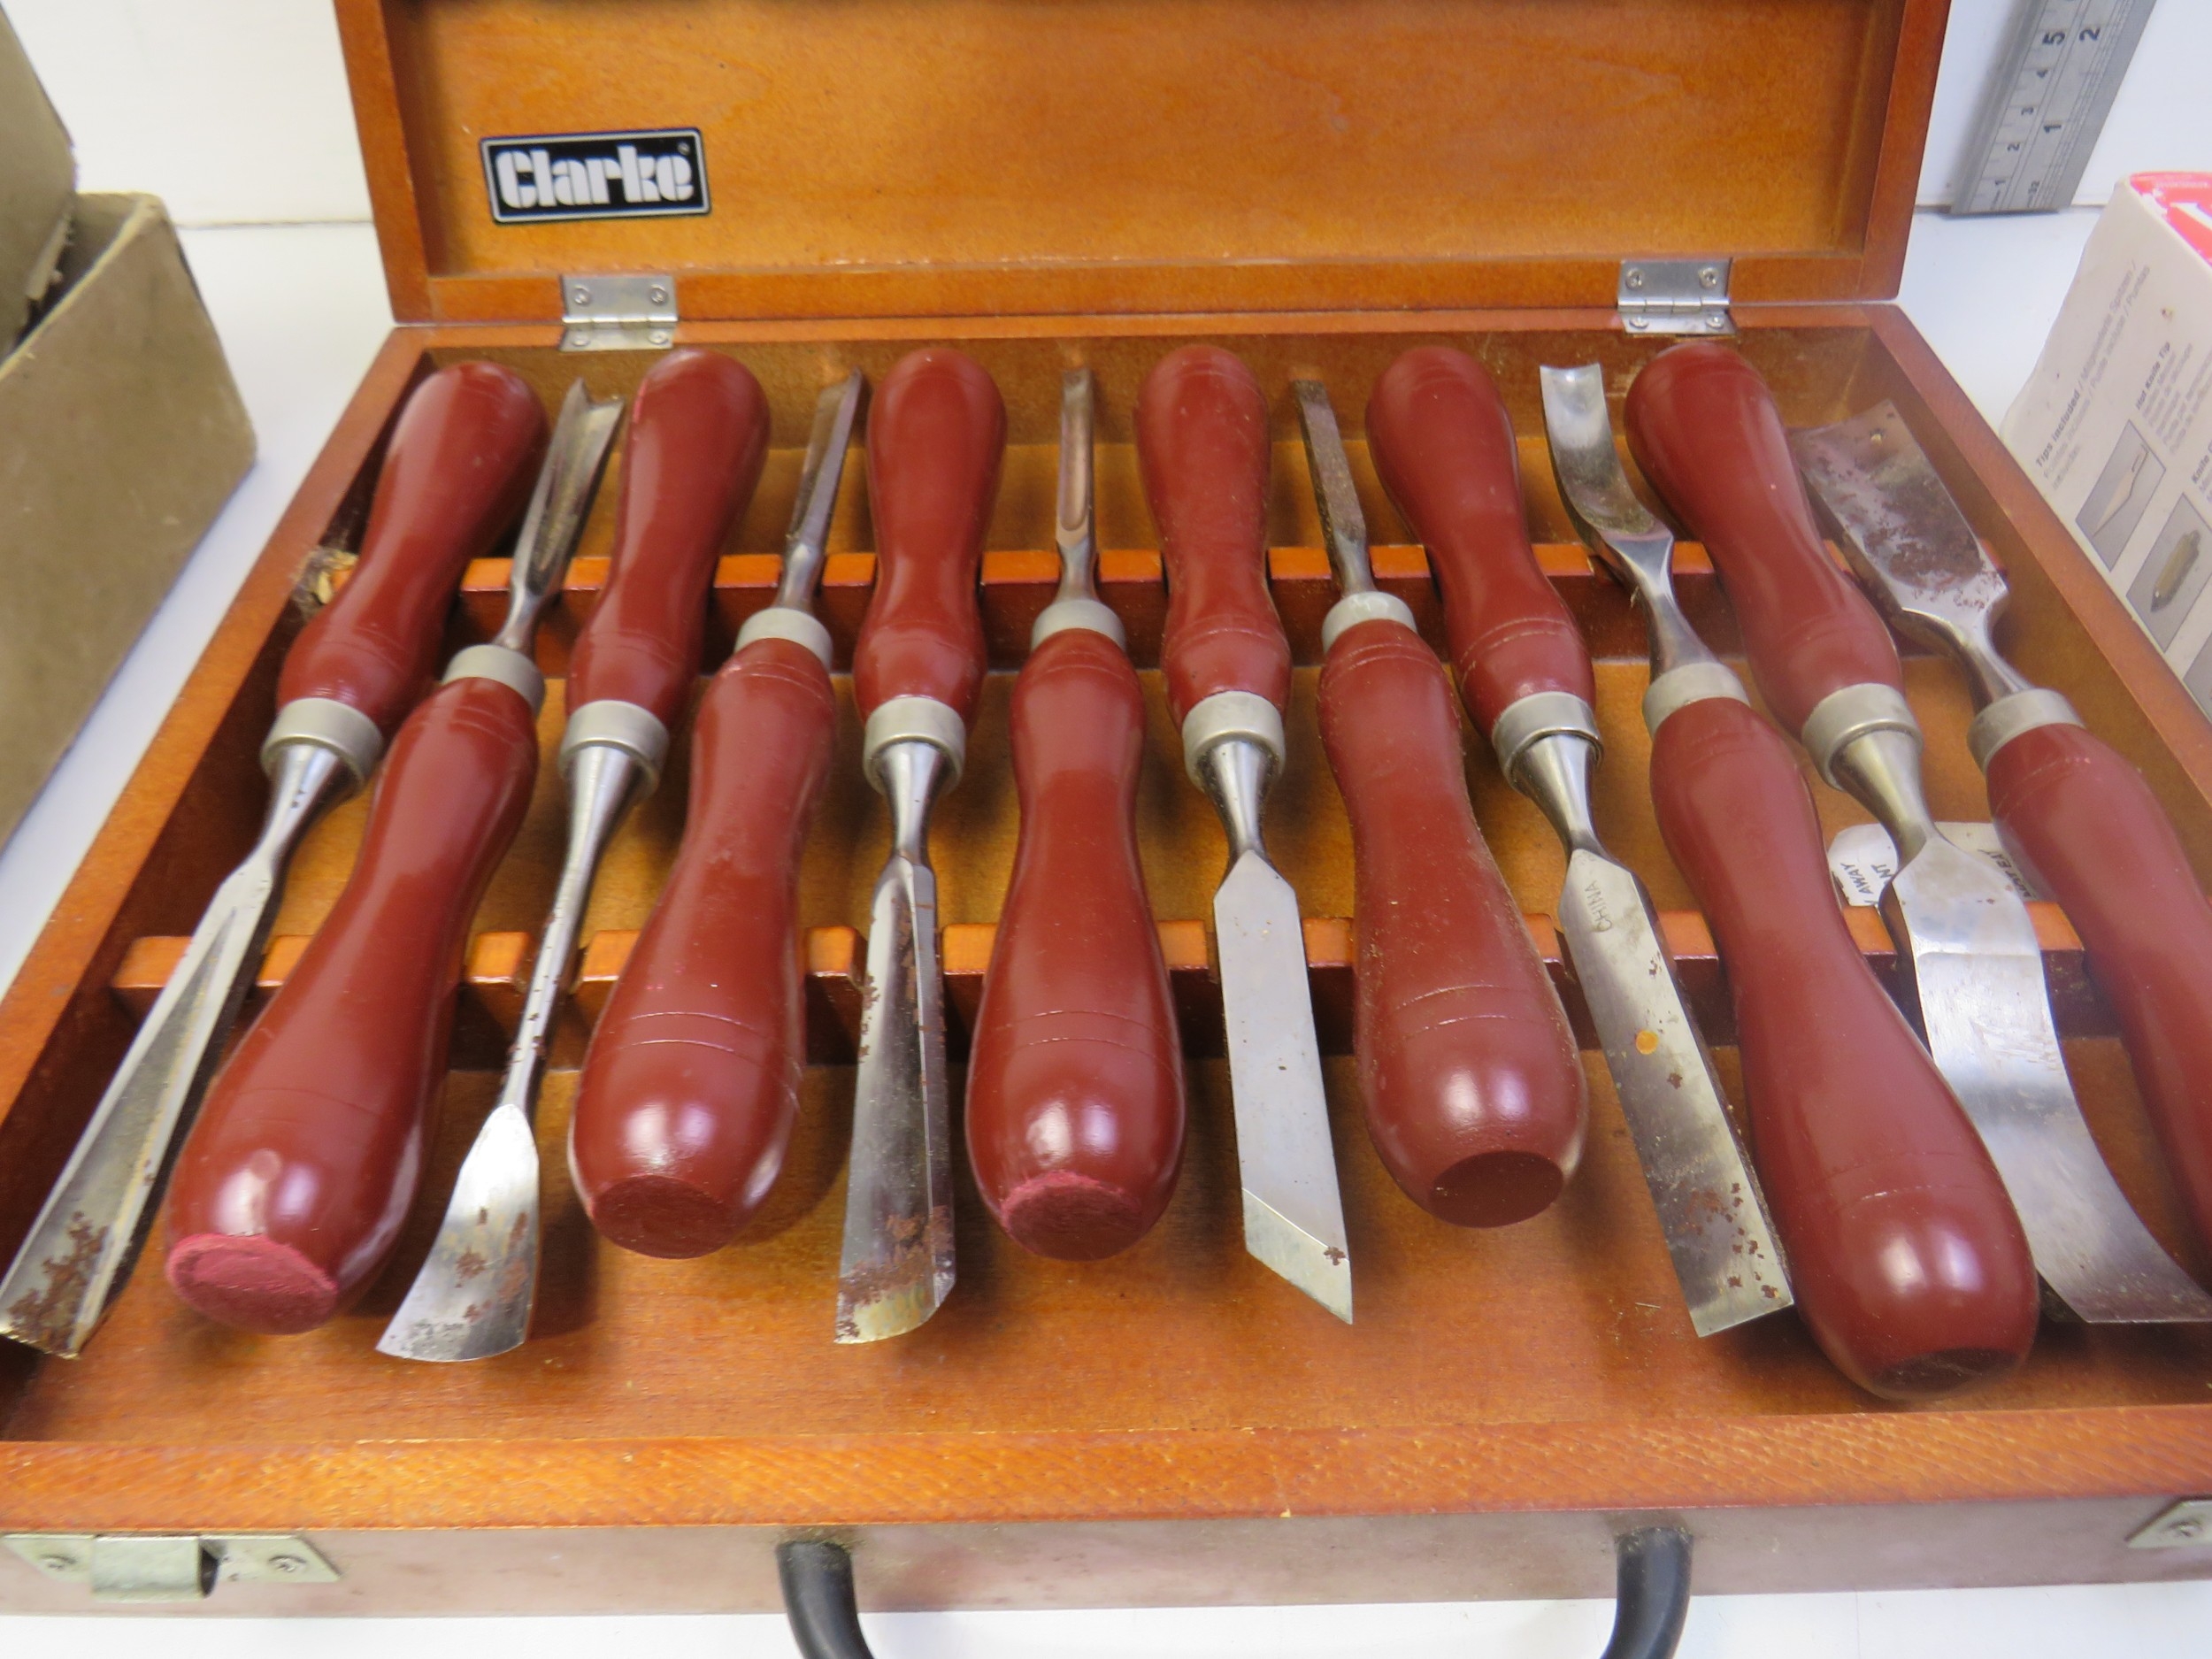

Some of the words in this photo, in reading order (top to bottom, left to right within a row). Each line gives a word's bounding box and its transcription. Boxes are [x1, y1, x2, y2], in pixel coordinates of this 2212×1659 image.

[2043, 32, 2066, 44] 5
[2079, 27, 2101, 41] 2
[2021, 106, 2034, 116] 3
[2044, 124, 2062, 134] 1
[495, 144, 694, 209] Clarke
[2035, 442, 2054, 468] Tips
[2052, 389, 2080, 442] included
[2192, 455, 2209, 484] Knife
[1840, 863, 1874, 895] AWAY
[1584, 879, 1613, 933] CHINA
